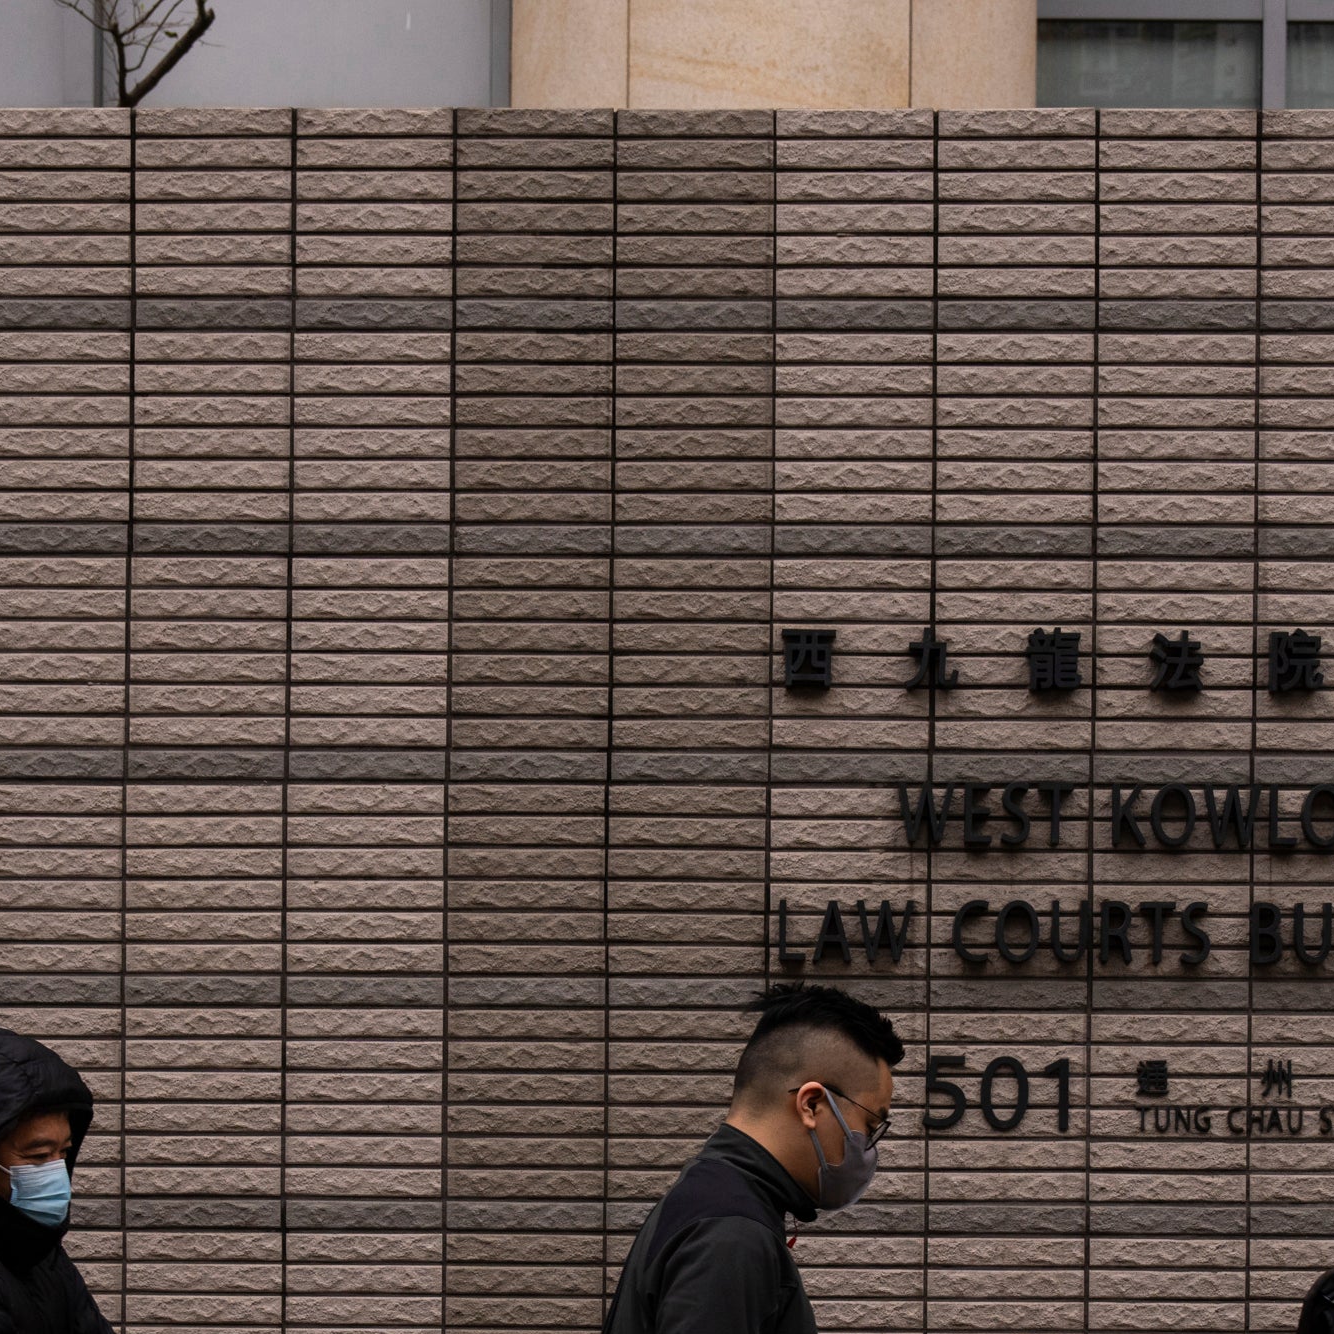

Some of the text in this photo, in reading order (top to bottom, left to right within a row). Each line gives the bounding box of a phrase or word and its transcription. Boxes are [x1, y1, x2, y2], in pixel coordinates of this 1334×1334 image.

[897, 780, 1075, 848] WEST
[778, 898, 915, 965] LAW
[951, 899, 1212, 967] COURTS
[923, 1054, 1070, 1133] 501
[1135, 1105, 1212, 1134] TUNG
[1226, 1106, 1303, 1136] CHAU
